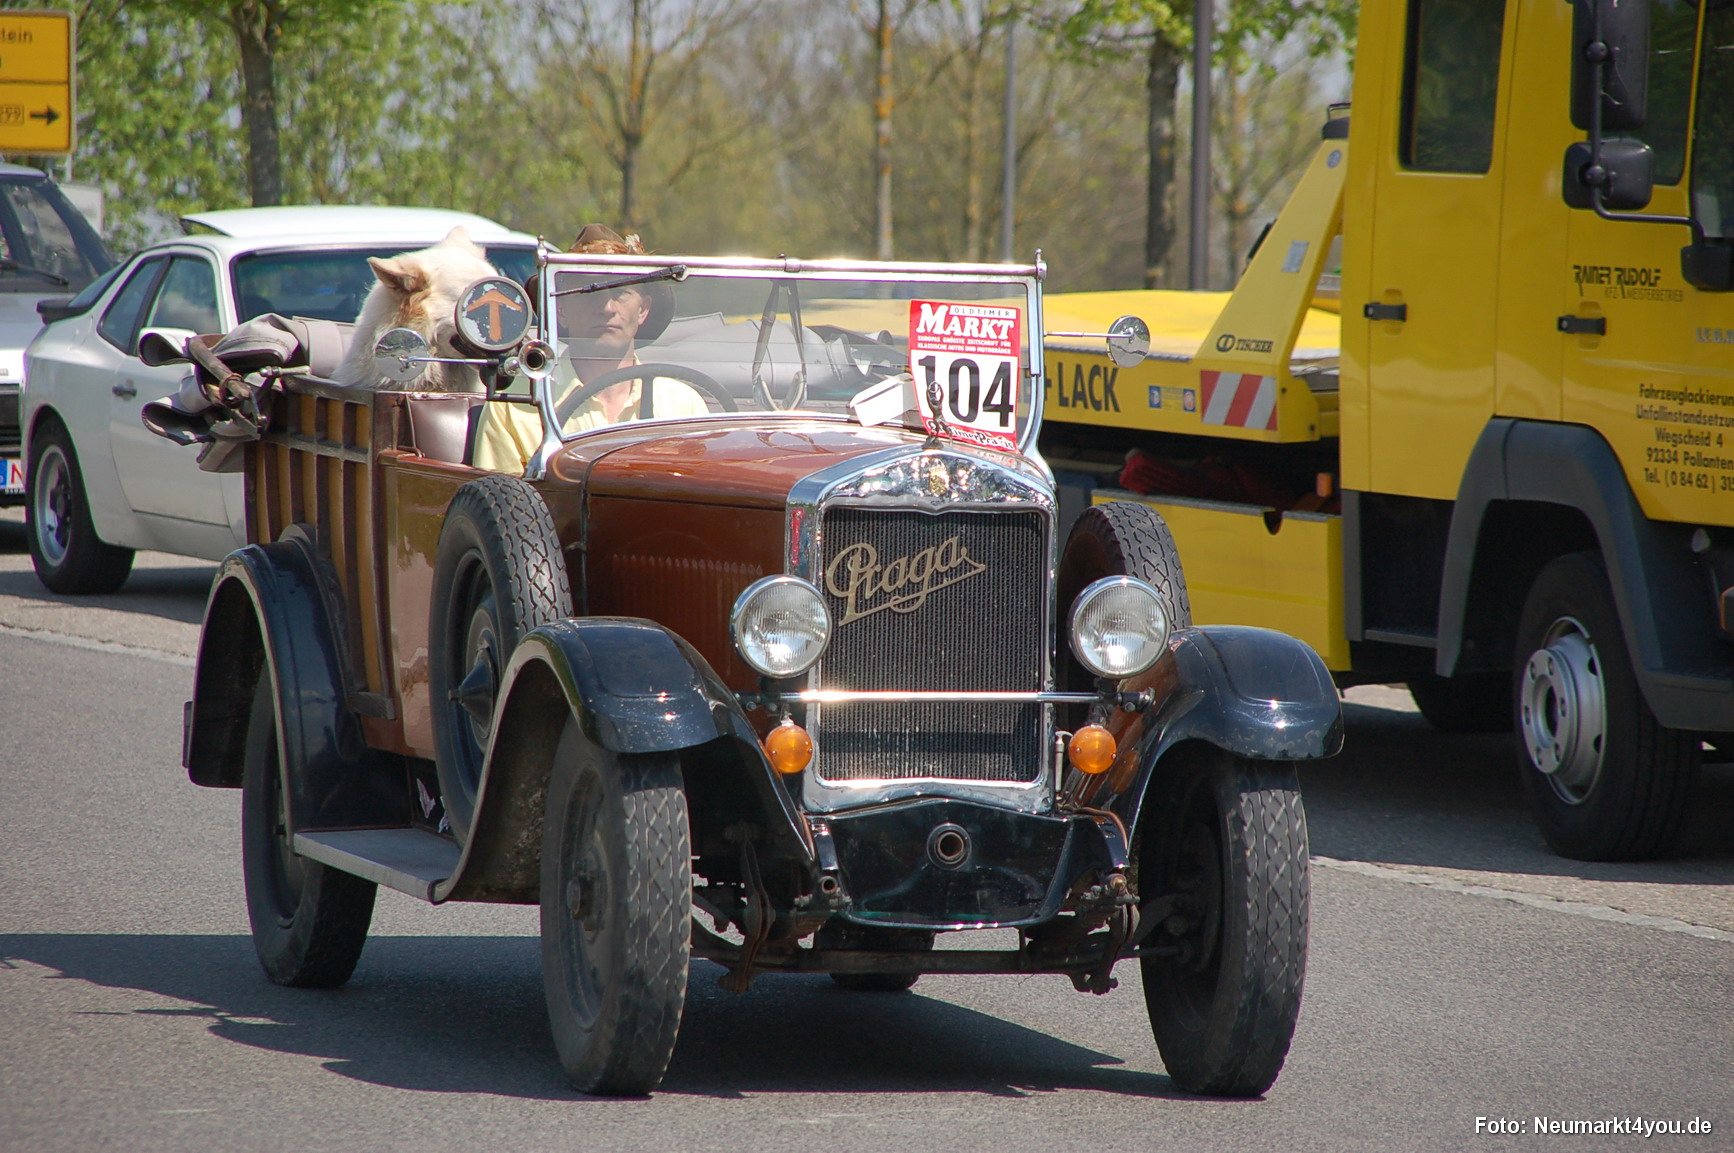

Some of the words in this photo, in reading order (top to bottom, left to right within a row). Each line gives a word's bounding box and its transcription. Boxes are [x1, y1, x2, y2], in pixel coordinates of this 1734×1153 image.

[1573, 265, 1611, 297] RAINER
[1614, 267, 1661, 299] RUDOLF
[916, 303, 1014, 340] MARKT
[954, 307, 1010, 316] OLDTIMER
[918, 355, 1014, 427] 104
[1058, 362, 1121, 412] LACK
[1655, 427, 1711, 448] Wegscheid
[1716, 433, 1723, 448] 4
[1644, 467, 1660, 484] Tel.
[1646, 447, 1678, 464] 92334
[1683, 451, 1734, 471] Pollanten
[826, 536, 985, 627] Praga
